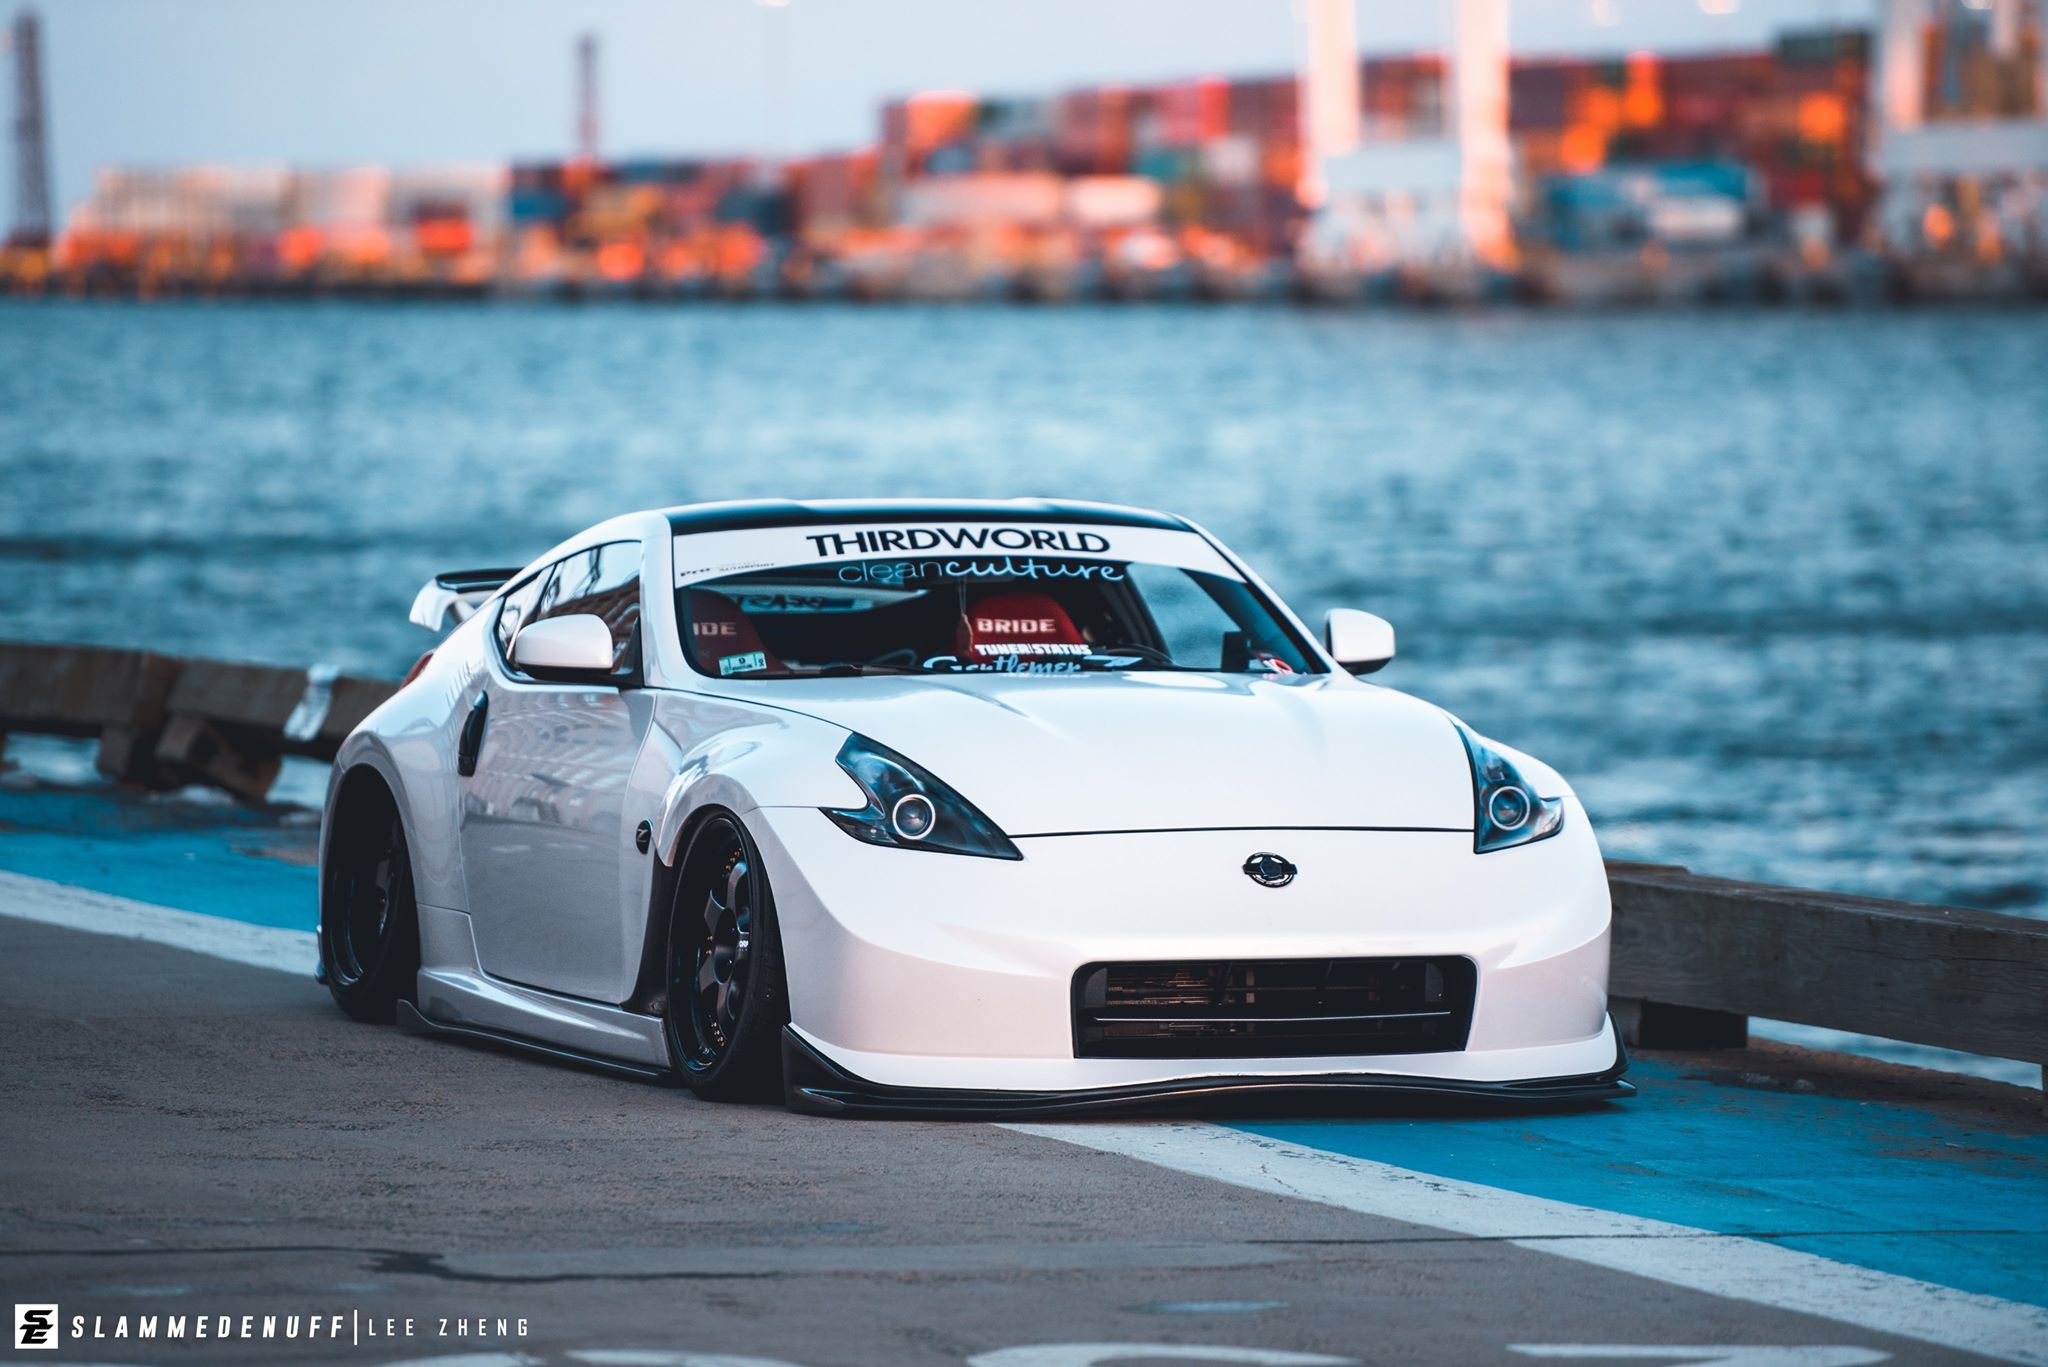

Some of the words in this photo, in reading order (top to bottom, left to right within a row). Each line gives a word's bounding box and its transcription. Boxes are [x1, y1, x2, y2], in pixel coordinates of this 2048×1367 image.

[806, 527, 1111, 557] THIRDWORLD
[692, 621, 737, 636] IDE
[976, 618, 1057, 634] BRIDE
